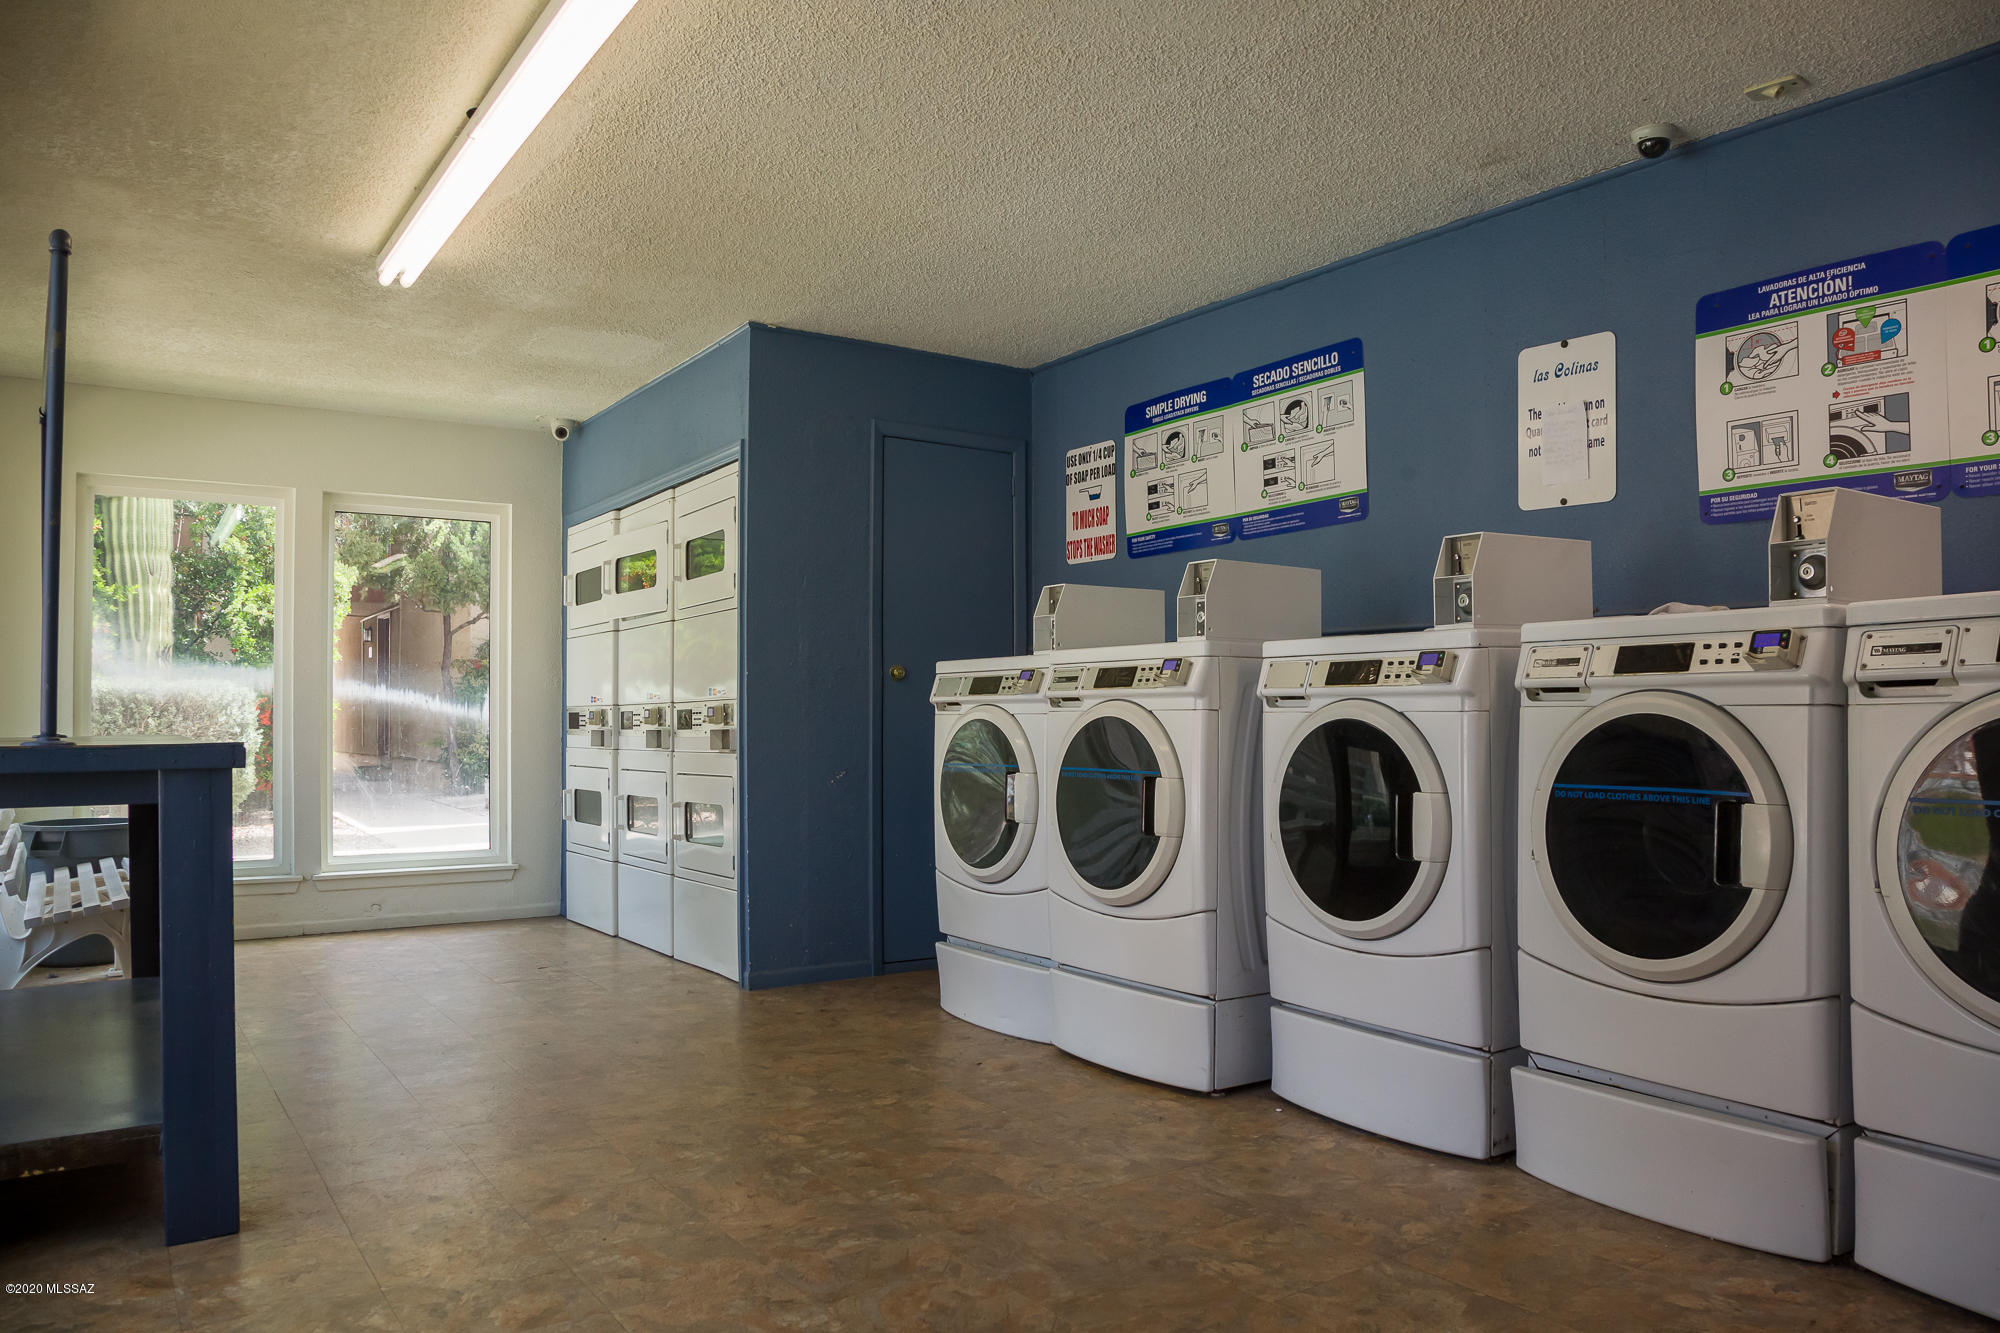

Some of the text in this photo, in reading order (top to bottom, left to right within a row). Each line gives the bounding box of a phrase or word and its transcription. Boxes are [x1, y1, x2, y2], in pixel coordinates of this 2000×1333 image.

[1758, 262, 1866, 294] LAVADORAS DE ALTA EFICIENCIA
[1769, 276, 1853, 308] ATENCIÓN!
[1748, 312, 1760, 320] LEA
[1762, 308, 1779, 318] PARA
[1780, 302, 1807, 313] LOGRAR
[1808, 299, 1818, 307] UN
[1820, 292, 1848, 304] LAVADO
[1253, 352, 1338, 388] SECADO SENCILLO
[1534, 360, 1599, 382] las Colinas
[1146, 390, 1207, 418] SIMPLE DRYING
[1528, 408, 1542, 420] The
[1595, 399, 1605, 409] on
[1592, 414, 1608, 427] card
[1067, 445, 1114, 468] USE ONLY 1/4 CUP
[1529, 437, 1605, 458] not ame
[1066, 463, 1115, 486] OF SOAP PER LOAD
[1898, 473, 1928, 482] MAYTAG
[1072, 506, 1109, 530] TO MUCH SOAP
[1066, 539, 1083, 560] STOPS
[1084, 538, 1093, 557] THE
[1094, 534, 1115, 556] WASHER
[1554, 790, 1711, 805] DO NOT LOAD CLOTHES ABOVE THIS LINE
[1932, 806, 1956, 816] NOT
[1958, 808, 1991, 818] LOAD
